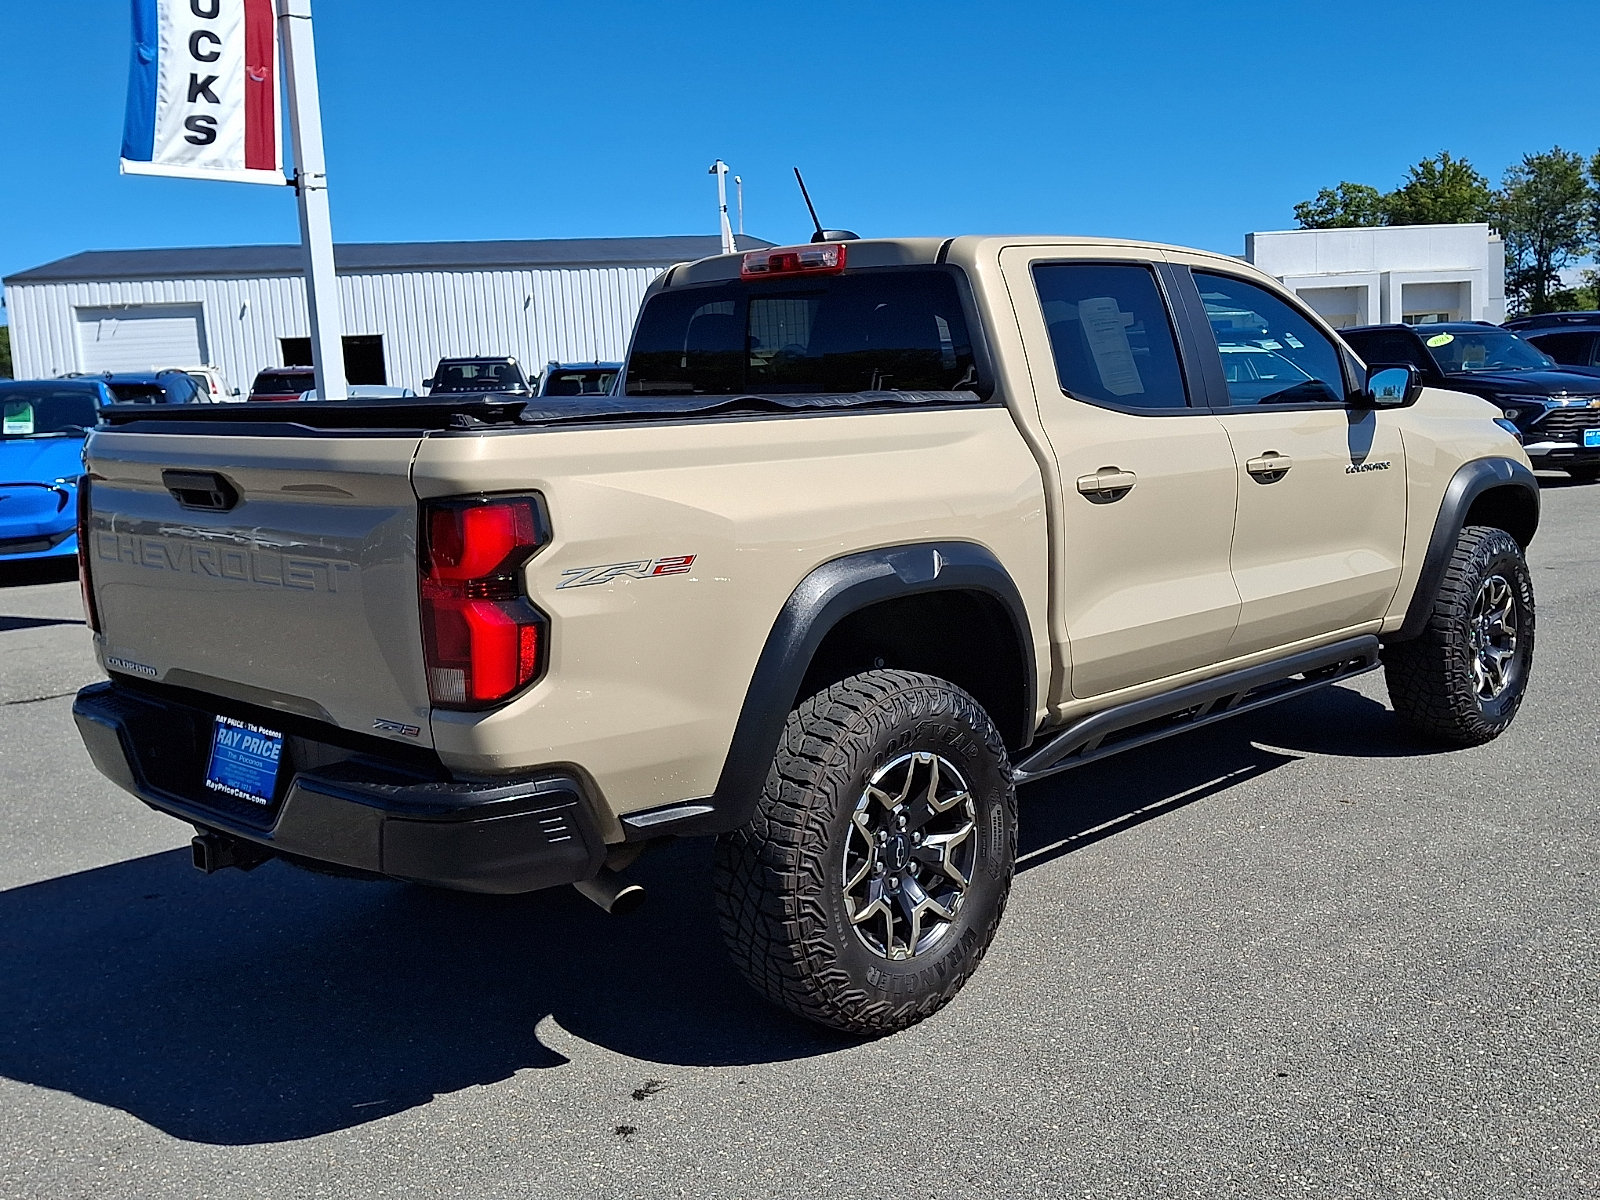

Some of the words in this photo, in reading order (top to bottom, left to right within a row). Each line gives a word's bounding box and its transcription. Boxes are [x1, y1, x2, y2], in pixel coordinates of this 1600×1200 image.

[97, 531, 356, 593] CHEVROLET
[555, 554, 697, 590] ZR2
[107, 656, 157, 676] COLORADO
[215, 714, 228, 724] RAY
[227, 717, 244, 729] PRICE
[247, 722, 258, 733] The
[259, 726, 282, 739] Poconos
[216, 728, 241, 748] RAY
[241, 735, 282, 760] PRICE
[205, 779, 267, 806] RayPriceCars.com
[864, 925, 979, 994] WRANGLER
